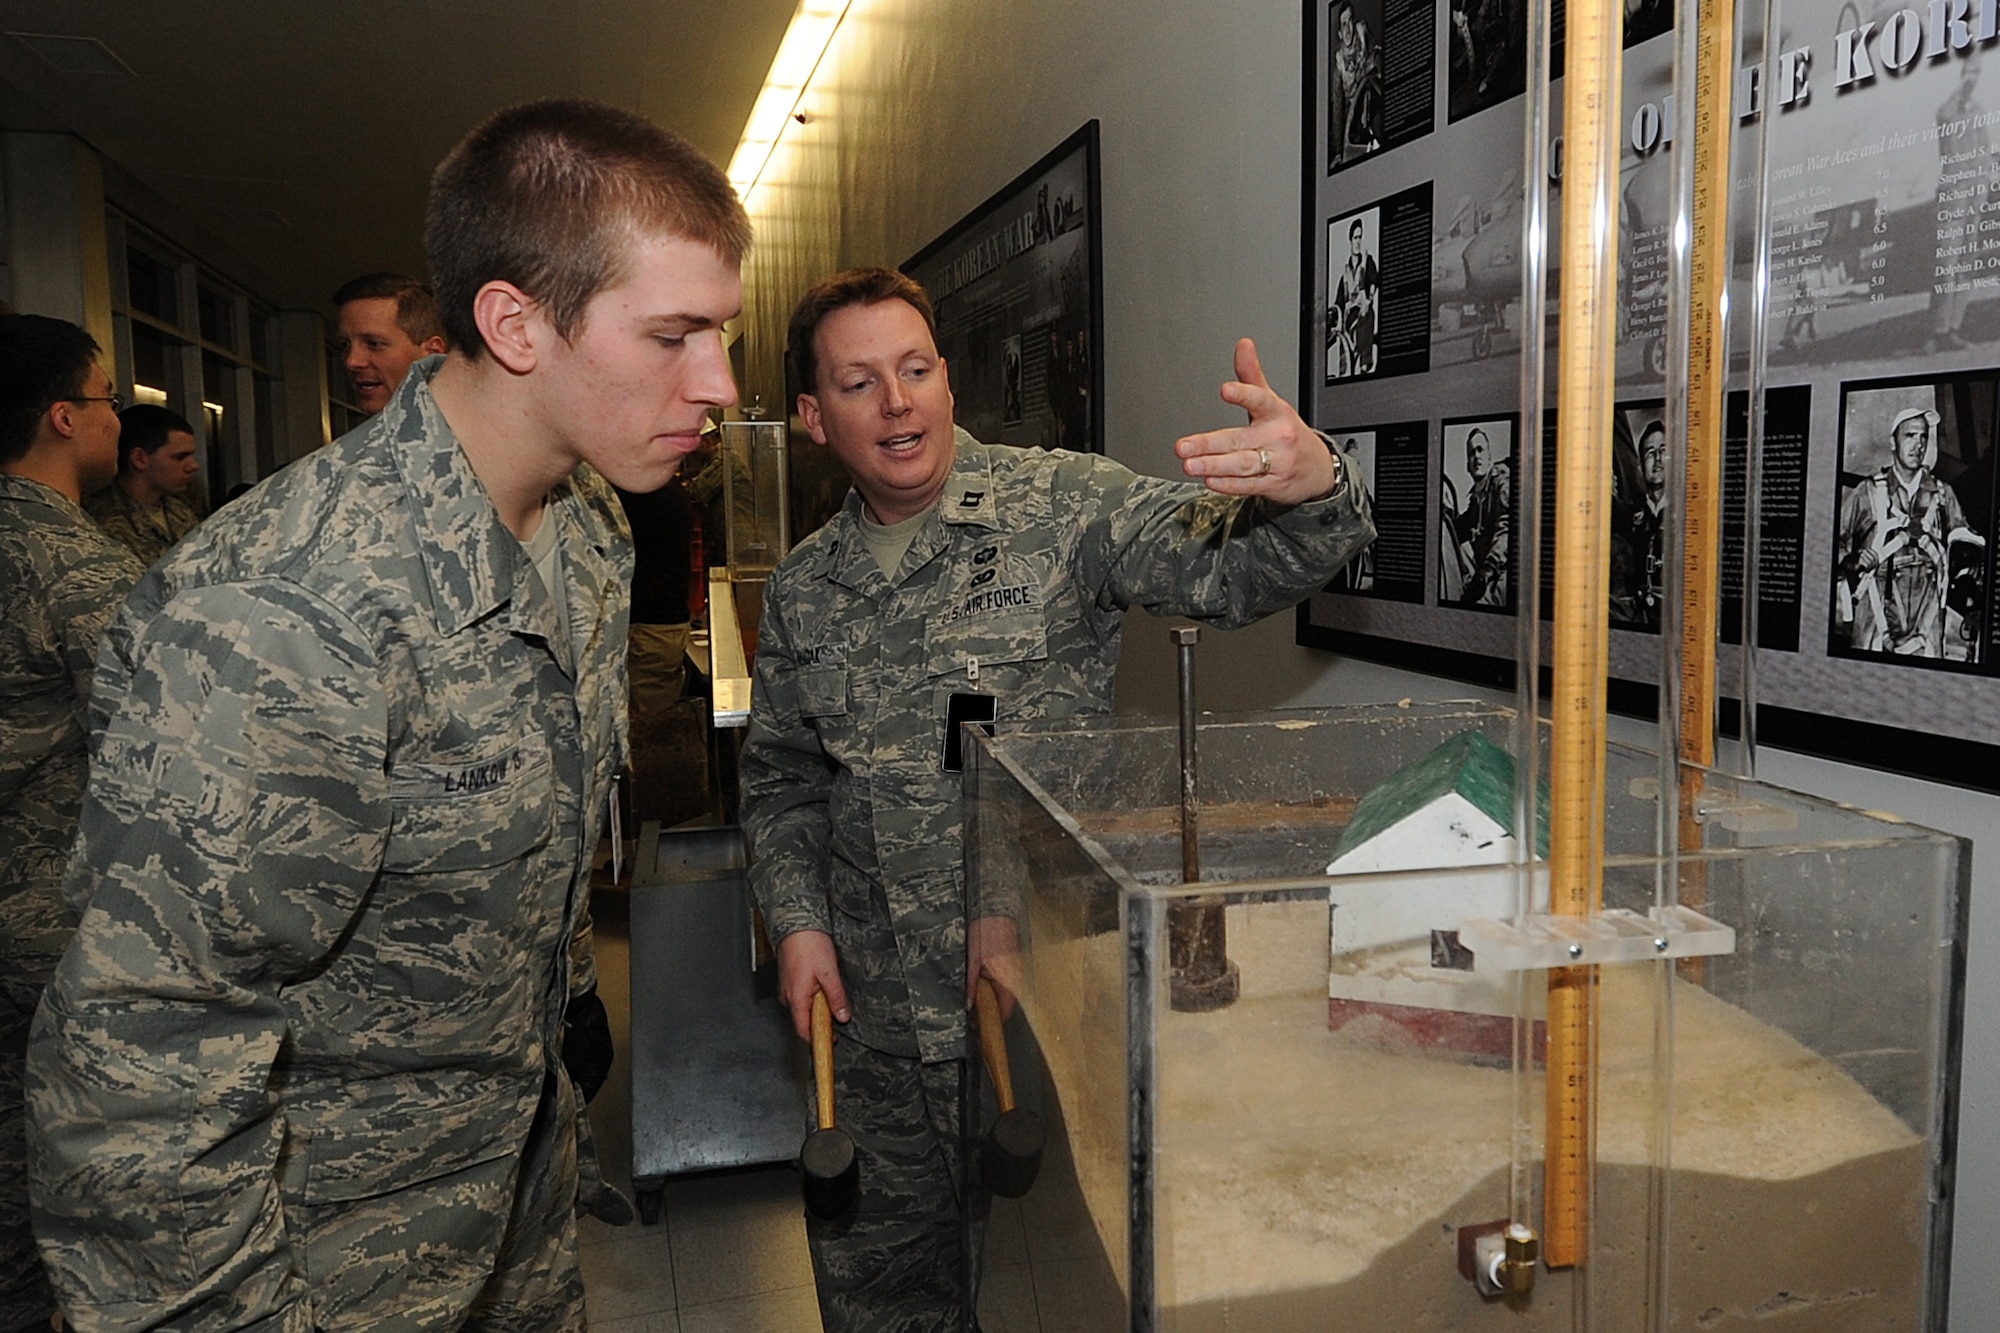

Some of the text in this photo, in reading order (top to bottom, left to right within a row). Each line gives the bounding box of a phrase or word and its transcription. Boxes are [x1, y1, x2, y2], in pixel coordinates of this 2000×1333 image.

[1771, 164, 1803, 183] orean
[1807, 156, 1829, 171] War
[1831, 147, 1857, 167] Aces
[1860, 135, 1886, 158] and
[1887, 129, 1918, 150] their
[1922, 118, 1971, 141] victory
[1940, 147, 1976, 167] Richard
[1938, 169, 1976, 185] Stephen
[1937, 185, 1975, 203] Richard
[1874, 205, 1888, 217] 6.5
[1873, 223, 1887, 235] 6.5
[1936, 226, 1964, 241] Ralph
[954, 231, 1001, 291] KOREAN
[1003, 211, 1036, 259] WAR
[1872, 240, 1887, 251] 6.0
[1936, 245, 1967, 258] Robert
[1871, 258, 1886, 269] 6.0
[1935, 262, 1972, 277] Dolphin
[1870, 276, 1885, 288] 5.0
[1934, 281, 1971, 295] William
[1870, 294, 1884, 305] 5.0
[964, 594, 983, 616] AIR
[986, 586, 1031, 609] FORCE
